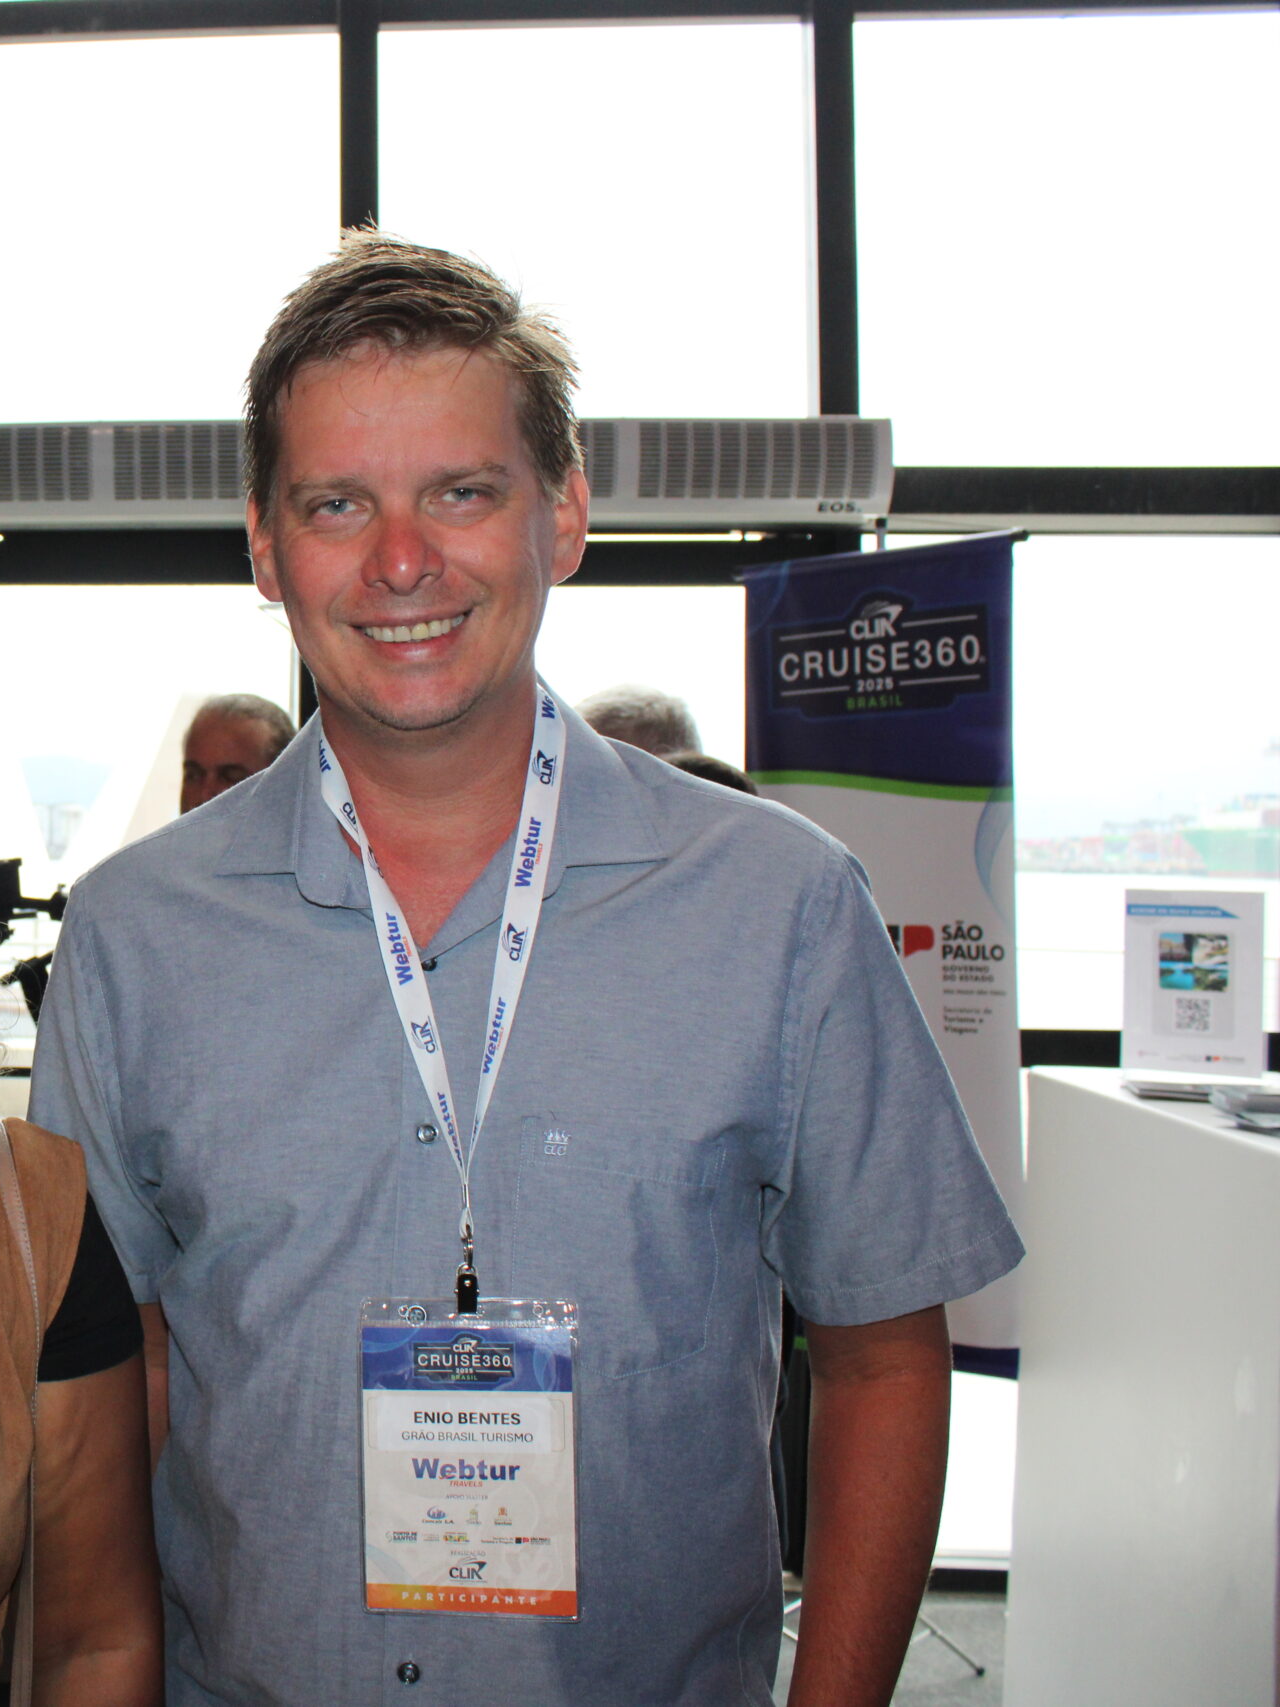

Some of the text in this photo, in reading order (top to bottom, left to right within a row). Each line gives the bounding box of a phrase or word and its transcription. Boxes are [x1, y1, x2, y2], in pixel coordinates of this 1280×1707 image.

[780, 636, 980, 682] CRUISE360
[856, 677, 894, 693] 2025
[846, 694, 903, 710] BRASIL
[514, 817, 542, 888] Webtur
[942, 920, 983, 941] SÃO
[385, 912, 413, 986] Webtur
[942, 944, 1005, 961] PAULO
[482, 997, 507, 1074] Webtur
[413, 1411, 521, 1426] ENIO BENTES
[401, 1429, 534, 1443] GRÃO BRASIL TURISMO
[412, 1457, 520, 1481] Webtur
[449, 1480, 483, 1488] TRAVELS
[401, 1591, 538, 1606] PARTICIPANTE
